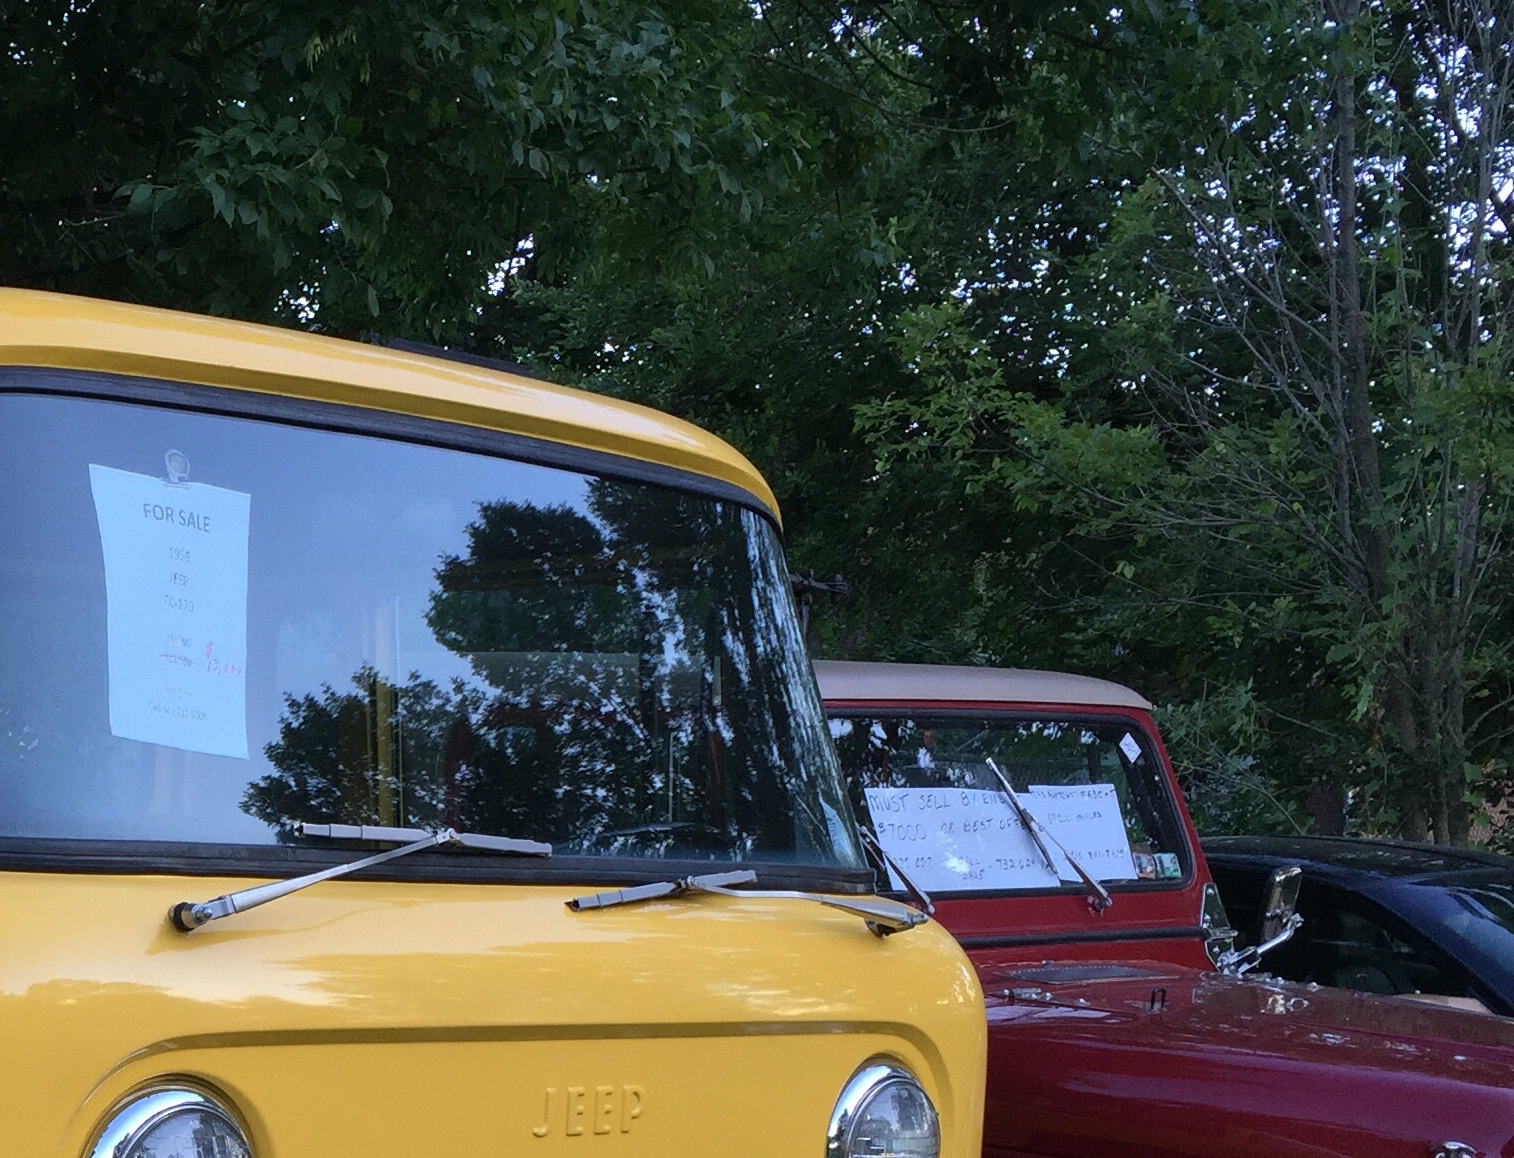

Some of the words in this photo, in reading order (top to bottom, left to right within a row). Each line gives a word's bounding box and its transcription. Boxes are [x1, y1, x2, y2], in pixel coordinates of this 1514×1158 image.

[143, 503, 175, 524] FOR
[178, 508, 211, 534] SALE
[168, 547, 191, 564] 1959
[169, 571, 189, 587] JEEP
[164, 594, 194, 613] FC-170
[869, 793, 910, 813] MUST
[918, 793, 951, 811] SELL
[961, 791, 977, 807] BY
[877, 822, 927, 842] $7000
[941, 821, 955, 834] OR
[963, 817, 993, 833] BEST
[532, 1084, 646, 1138] JEEP
